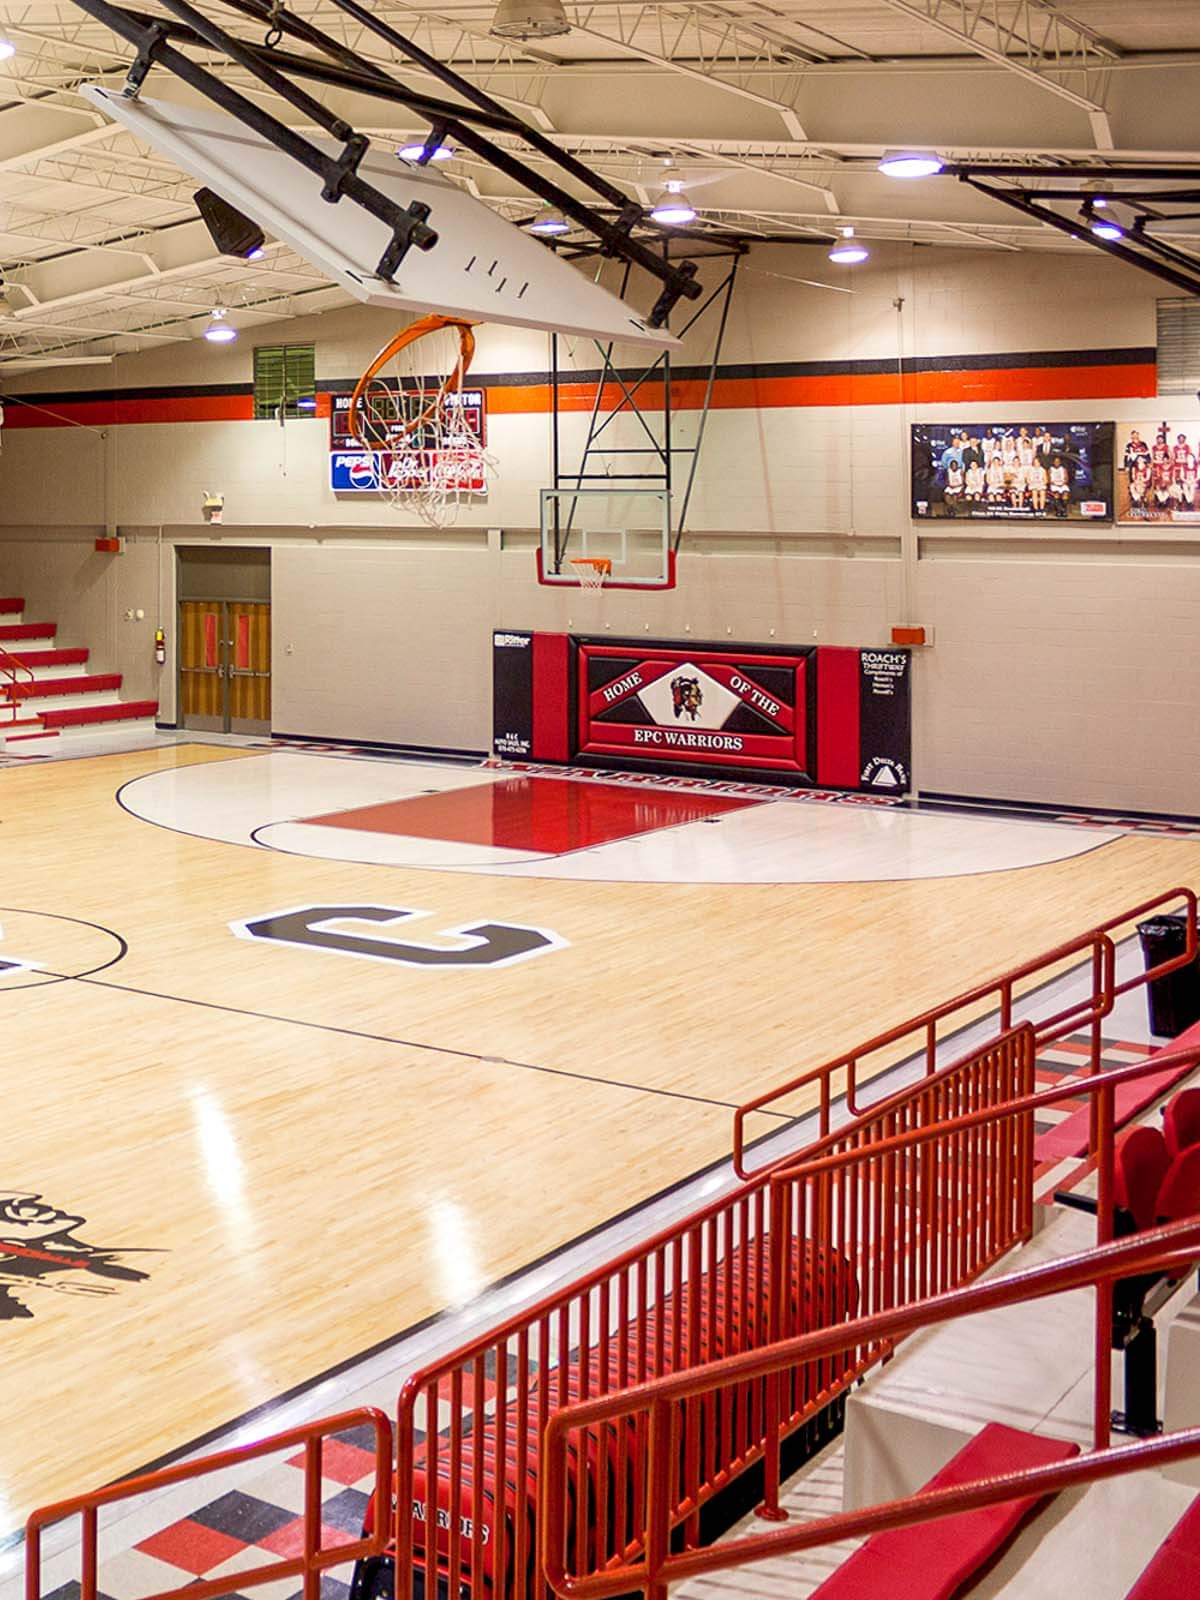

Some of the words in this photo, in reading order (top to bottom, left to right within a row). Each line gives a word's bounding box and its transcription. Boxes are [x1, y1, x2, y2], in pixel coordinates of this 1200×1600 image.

[861, 652, 906, 665] ROACH'S
[603, 672, 643, 702] HOME
[729, 675, 751, 694] OF
[750, 689, 781, 716] THE
[634, 729, 663, 744] EPC
[664, 732, 744, 750] WARRIORS
[228, 903, 572, 969] C
